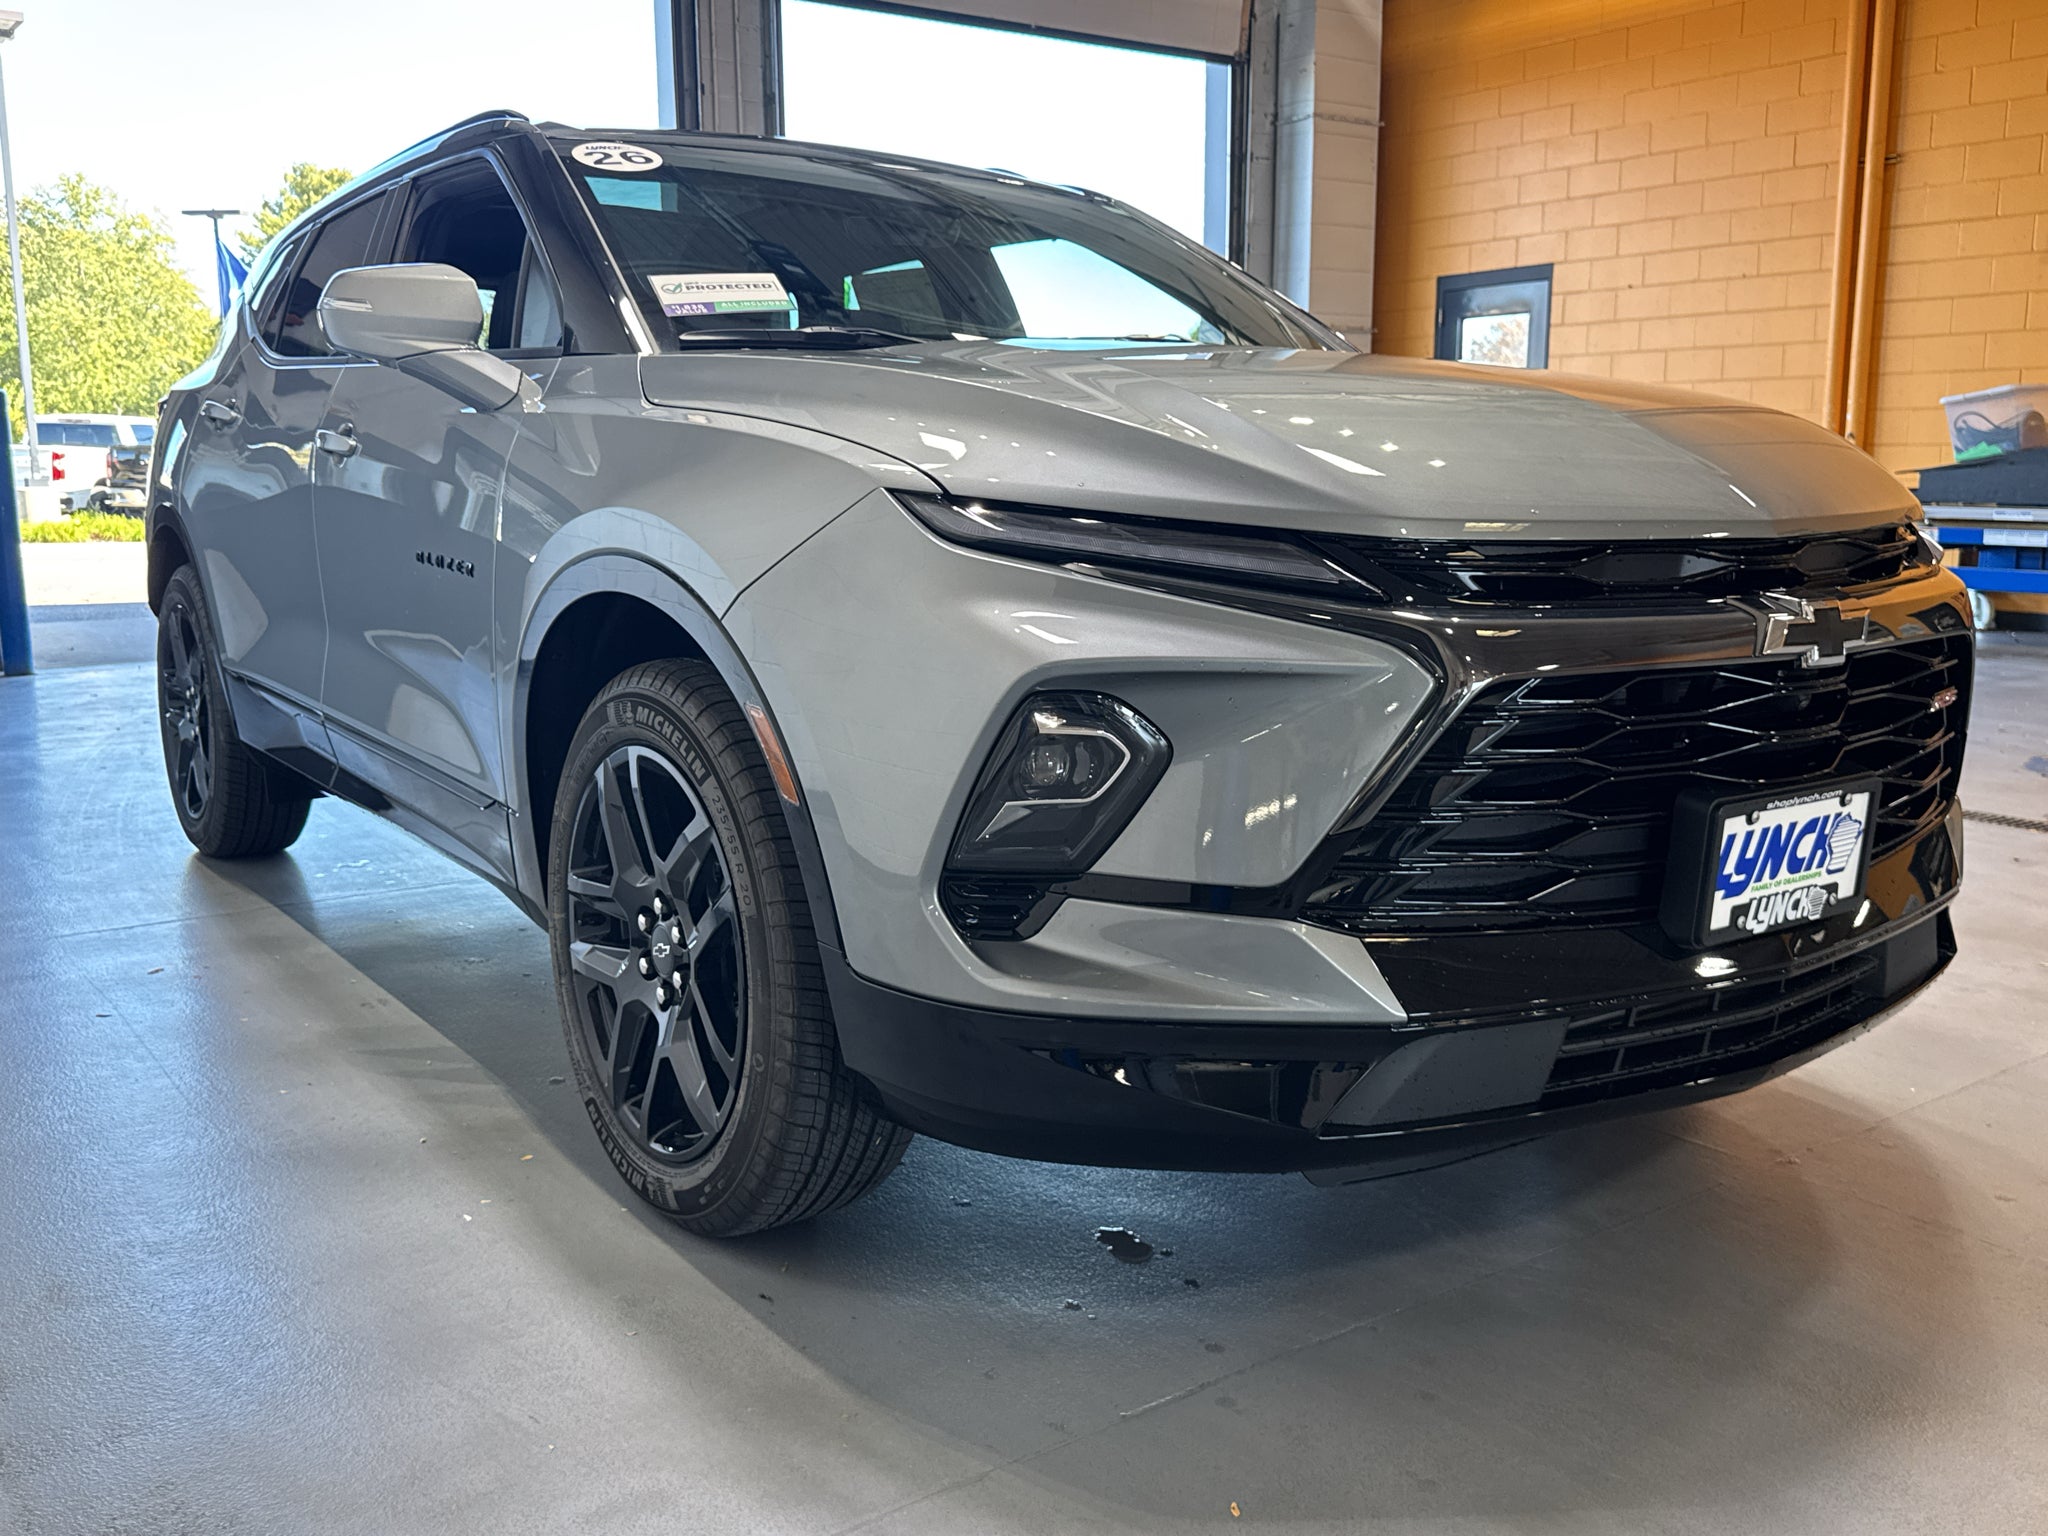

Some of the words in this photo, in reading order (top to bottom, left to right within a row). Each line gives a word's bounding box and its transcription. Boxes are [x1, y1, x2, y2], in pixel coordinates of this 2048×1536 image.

[584, 151, 654, 165] 26
[685, 283, 772, 291] PROTECTED
[635, 705, 706, 780] MICHELIN
[1766, 789, 1843, 810] shoplynch.com
[711, 795, 740, 856] 235/55
[735, 863, 744, 874] R
[740, 883, 752, 906] 20
[1716, 812, 1843, 900] LYNCH
[1751, 882, 1772, 893] FAMILY
[1773, 879, 1782, 887] OF
[1783, 871, 1822, 886] DEALERSHIPS
[1745, 886, 1811, 935] LYNCH
[587, 1103, 645, 1191] MICHELIN
